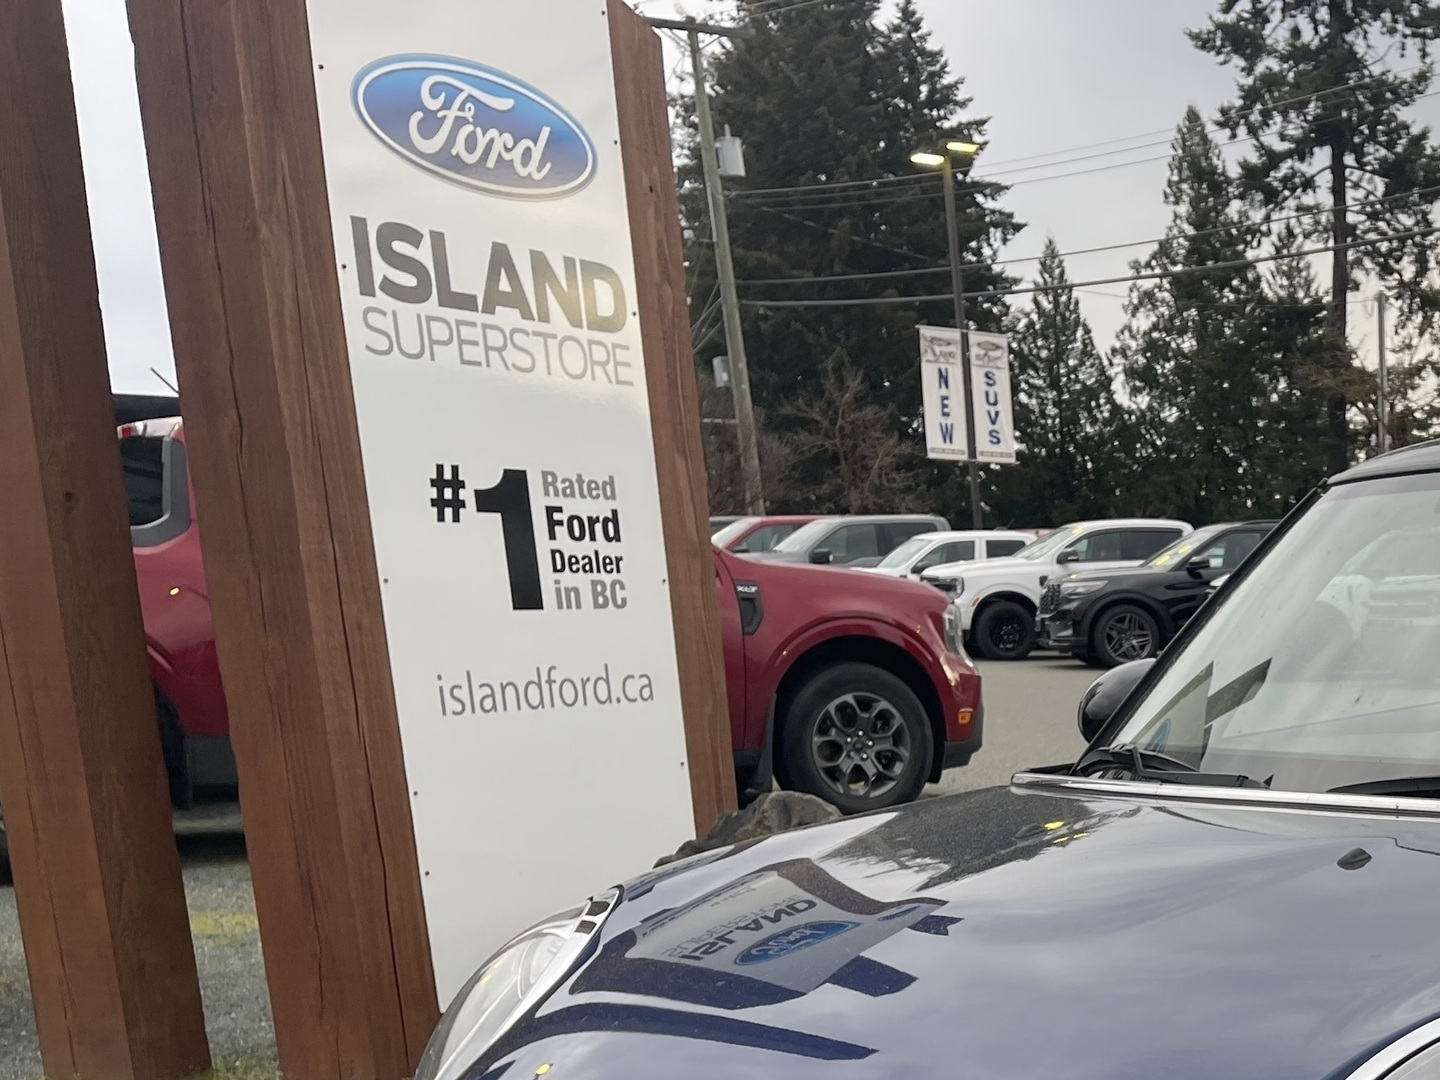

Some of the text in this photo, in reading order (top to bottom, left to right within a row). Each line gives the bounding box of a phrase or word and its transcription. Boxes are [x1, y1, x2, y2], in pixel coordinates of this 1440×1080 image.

[408, 74, 551, 181] Ford
[349, 214, 627, 334] ISLAND
[362, 306, 634, 387] SUPERSTORE
[937, 367, 954, 444] NEW
[541, 470, 617, 501] Rated
[544, 505, 622, 543] Ford
[550, 548, 624, 574] Dealer
[554, 579, 628, 610] in BC
[436, 663, 655, 716] islandford.ca
